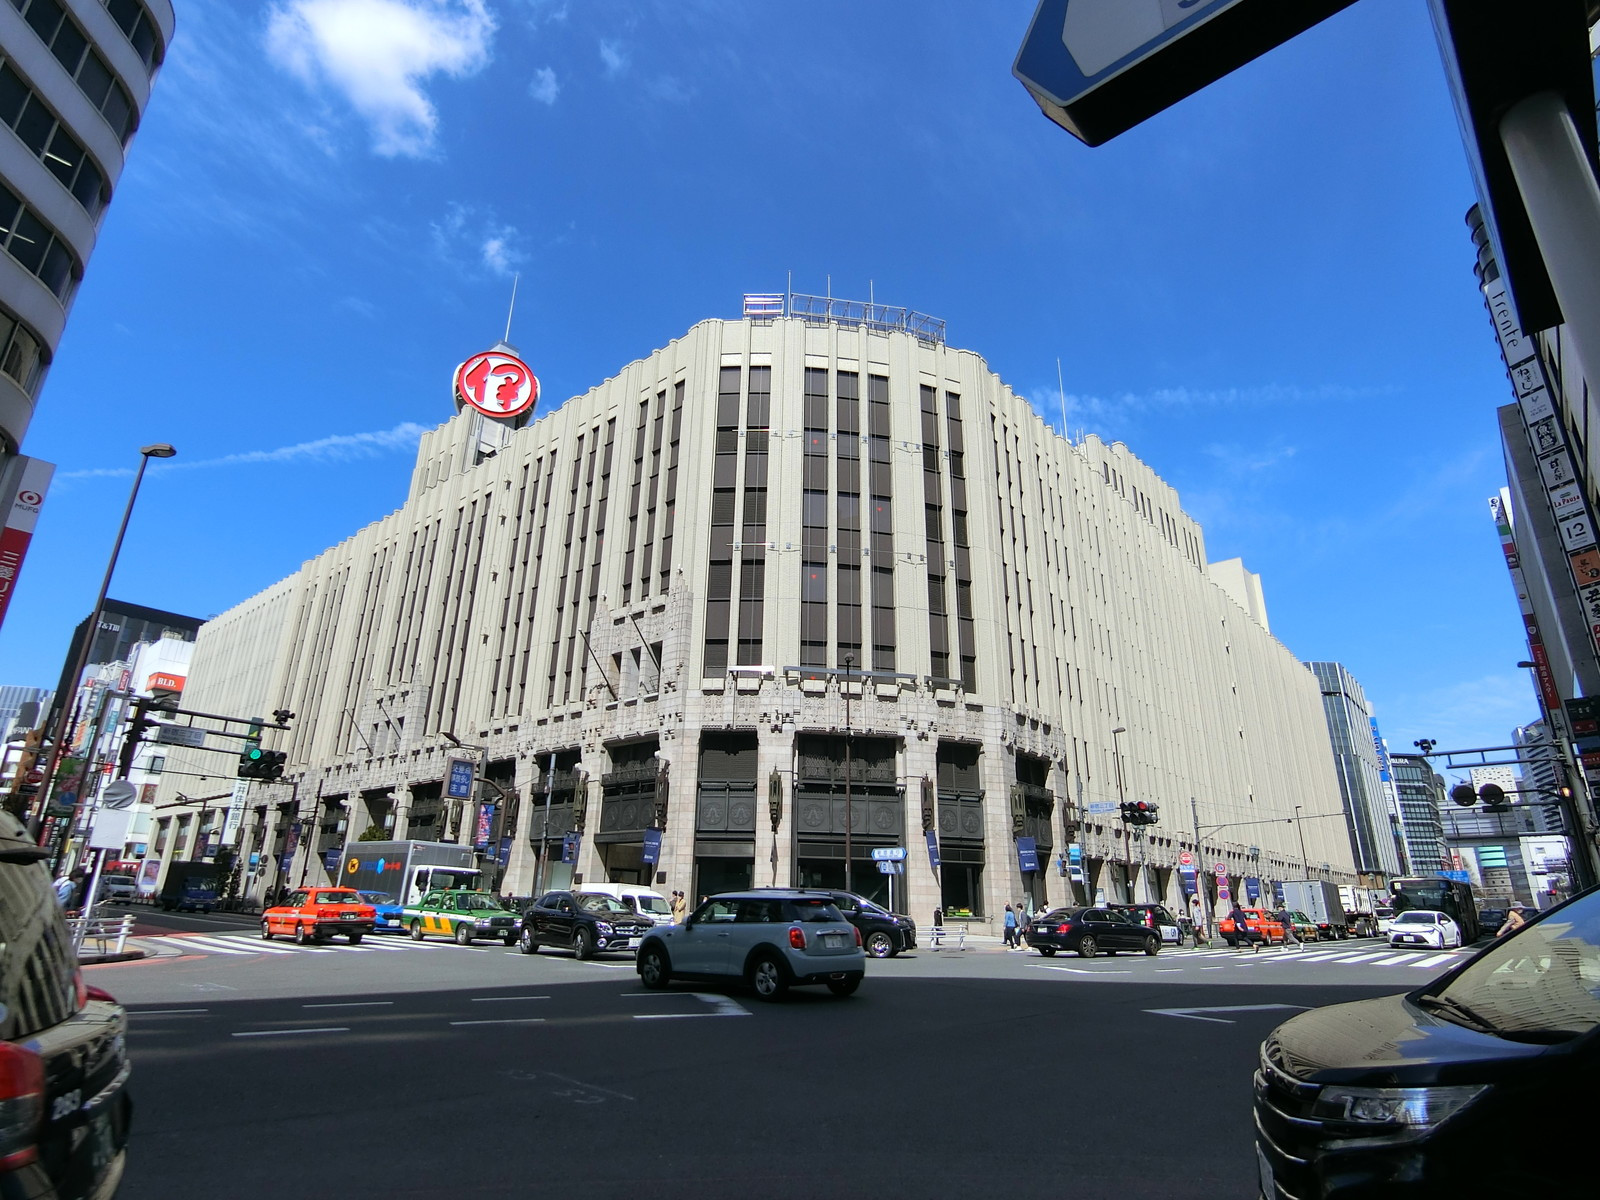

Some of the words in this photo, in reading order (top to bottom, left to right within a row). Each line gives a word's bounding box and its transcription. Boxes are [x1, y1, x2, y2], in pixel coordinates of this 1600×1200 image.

[1516, 368, 1534, 391] ねぎし
[1553, 500, 1562, 508] La
[1562, 494, 1581, 506] Pausa
[14, 503, 39, 514] MUFG
[157, 677, 176, 688] BLD.
